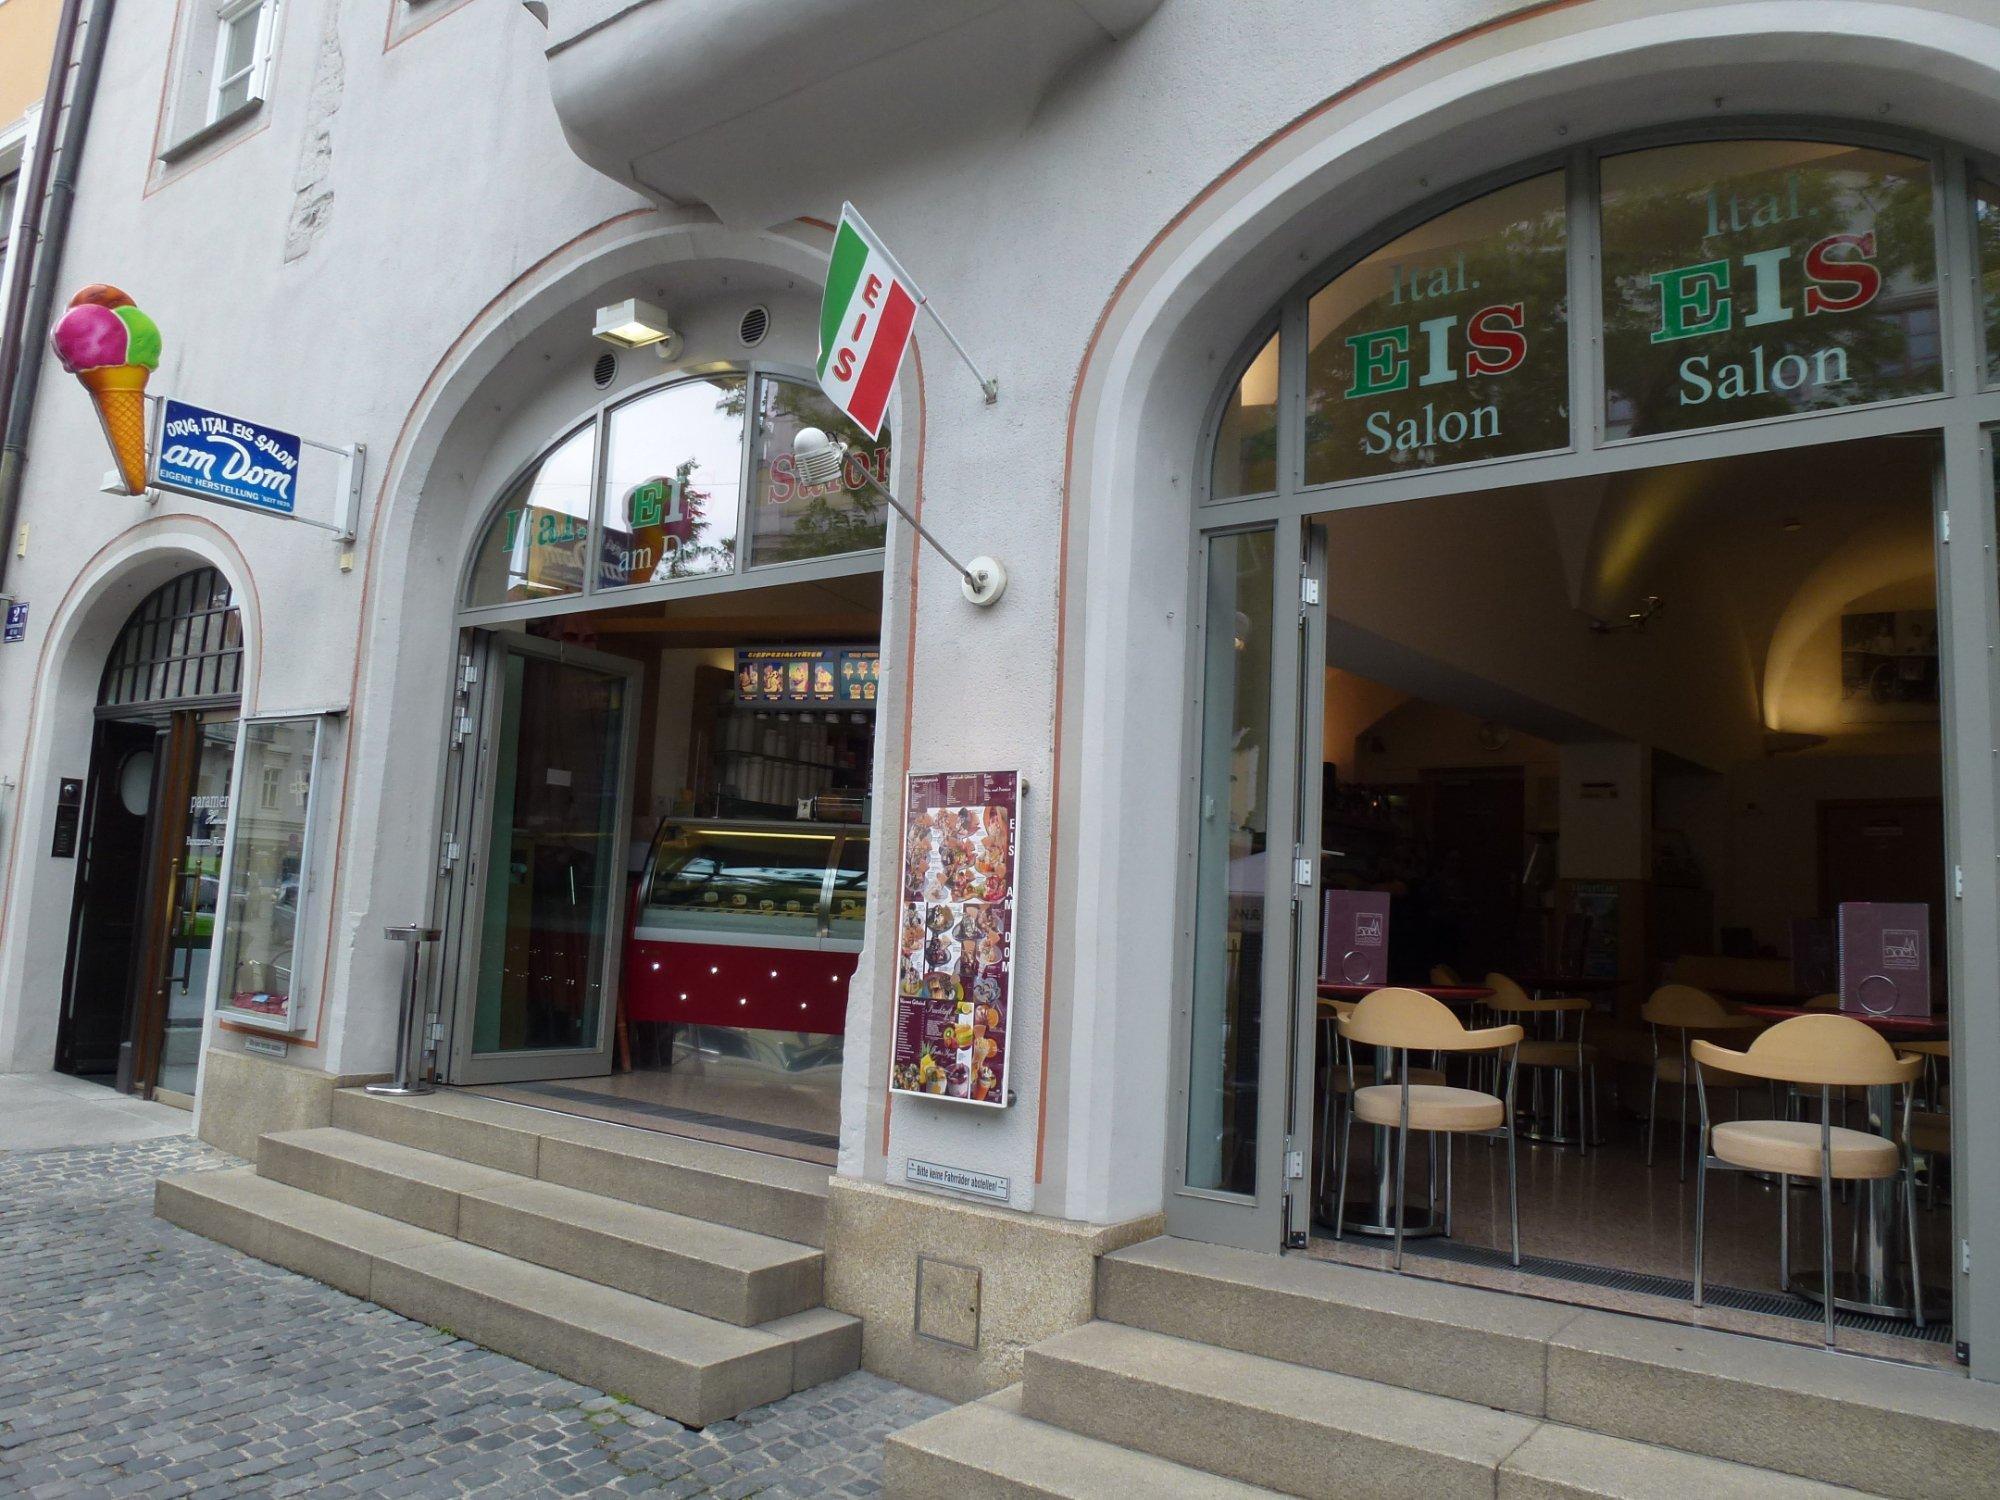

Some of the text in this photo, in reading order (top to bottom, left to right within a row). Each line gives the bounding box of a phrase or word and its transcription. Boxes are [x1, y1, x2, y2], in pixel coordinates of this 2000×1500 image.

[1706, 176, 1818, 238] Ital.
[1391, 255, 1481, 307] Ital.
[1649, 229, 1882, 345] EIS
[832, 274, 882, 383] EIS
[1344, 302, 1528, 400] EIS
[1679, 342, 1851, 406] Salon
[167, 418, 201, 437] ORIG.
[232, 423, 254, 442] EIS
[254, 434, 297, 470] SALON
[1365, 404, 1500, 455] Salon
[160, 469, 194, 485] EIGENE
[195, 477, 259, 501] HERSTELLUNG
[161, 435, 291, 500] am Dom
[768, 447, 891, 504] Son
[619, 546, 653, 572] am
[1008, 818, 1016, 856] EIS
[1004, 886, 1013, 910] AM
[1001, 931, 1011, 973] DOM
[916, 1165, 929, 1178] Bitte
[929, 1168, 943, 1181] keine
[944, 1170, 970, 1186] Fahrräder
